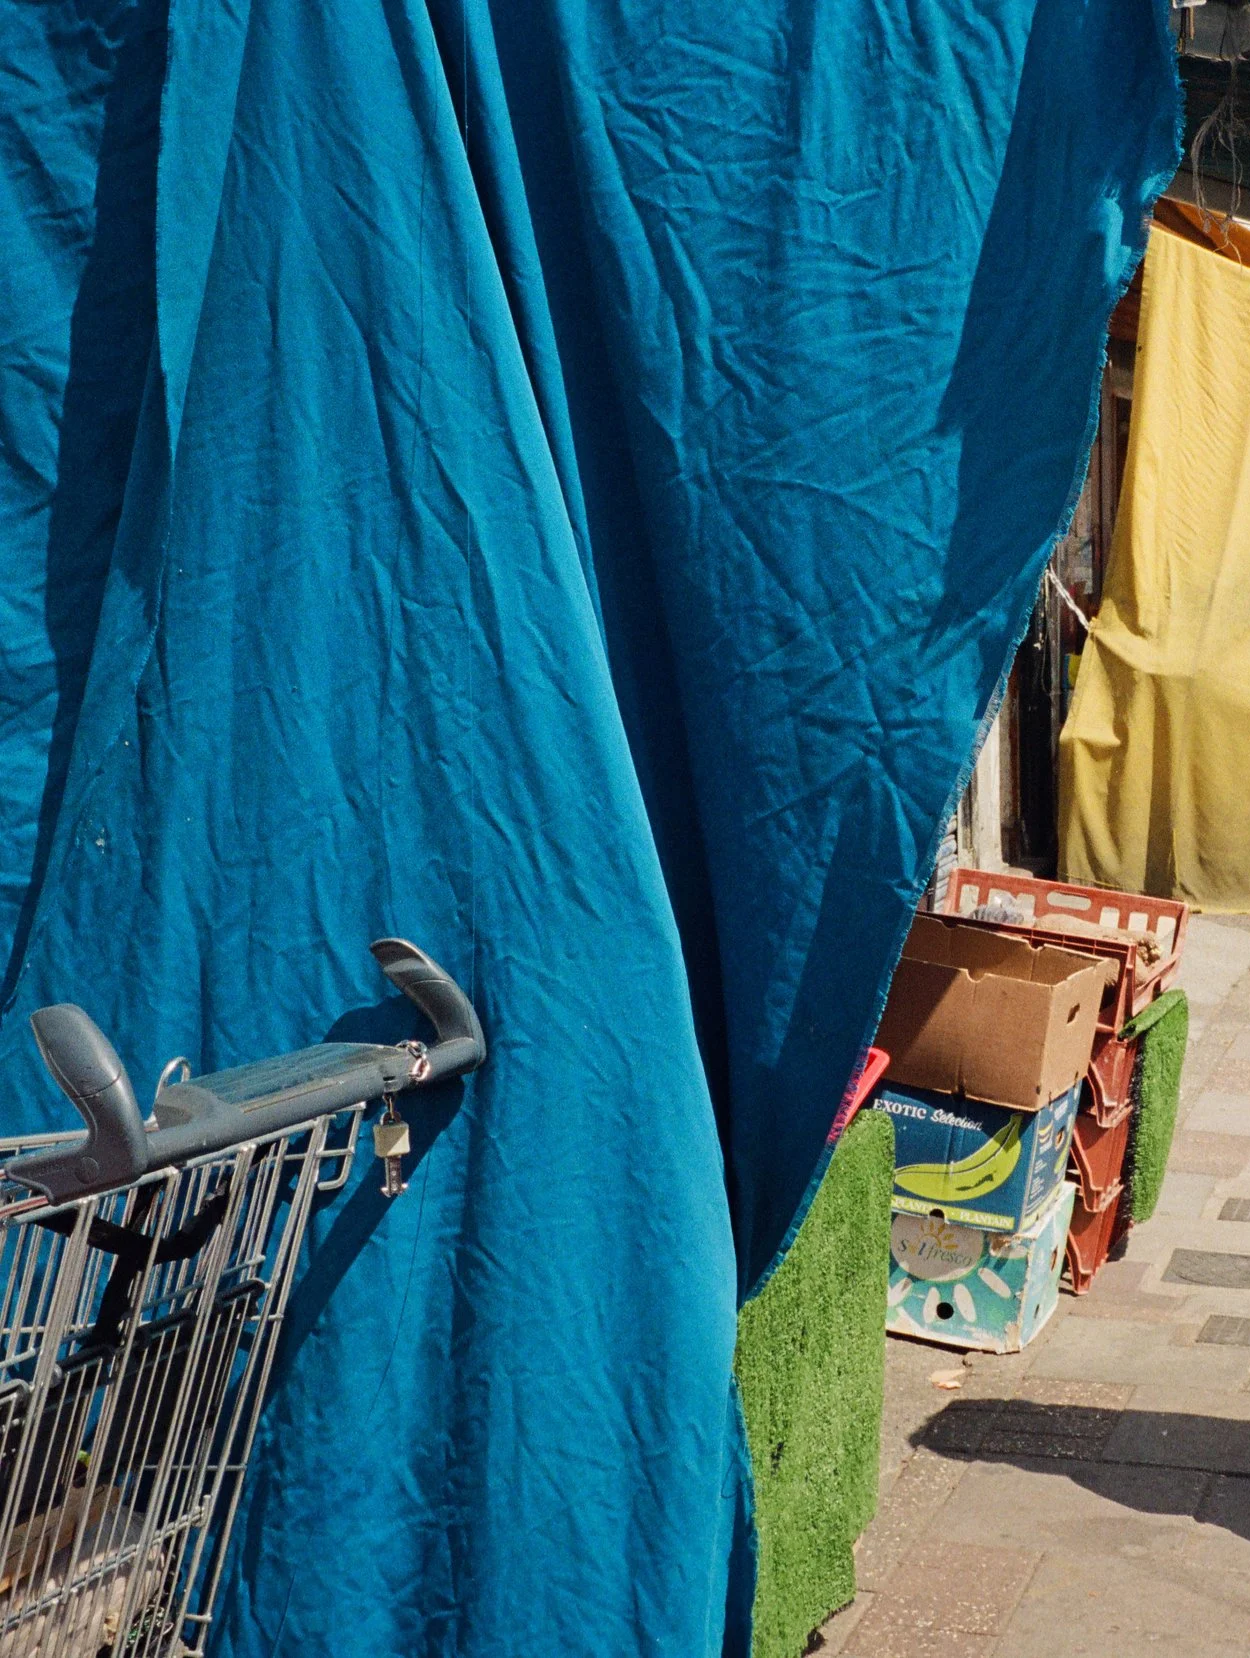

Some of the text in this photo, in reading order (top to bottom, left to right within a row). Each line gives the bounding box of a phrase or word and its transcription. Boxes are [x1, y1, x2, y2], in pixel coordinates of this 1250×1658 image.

[873, 1098, 984, 1131] EXOTIC Selection
[960, 1208, 1011, 1228] PLANTAIN
